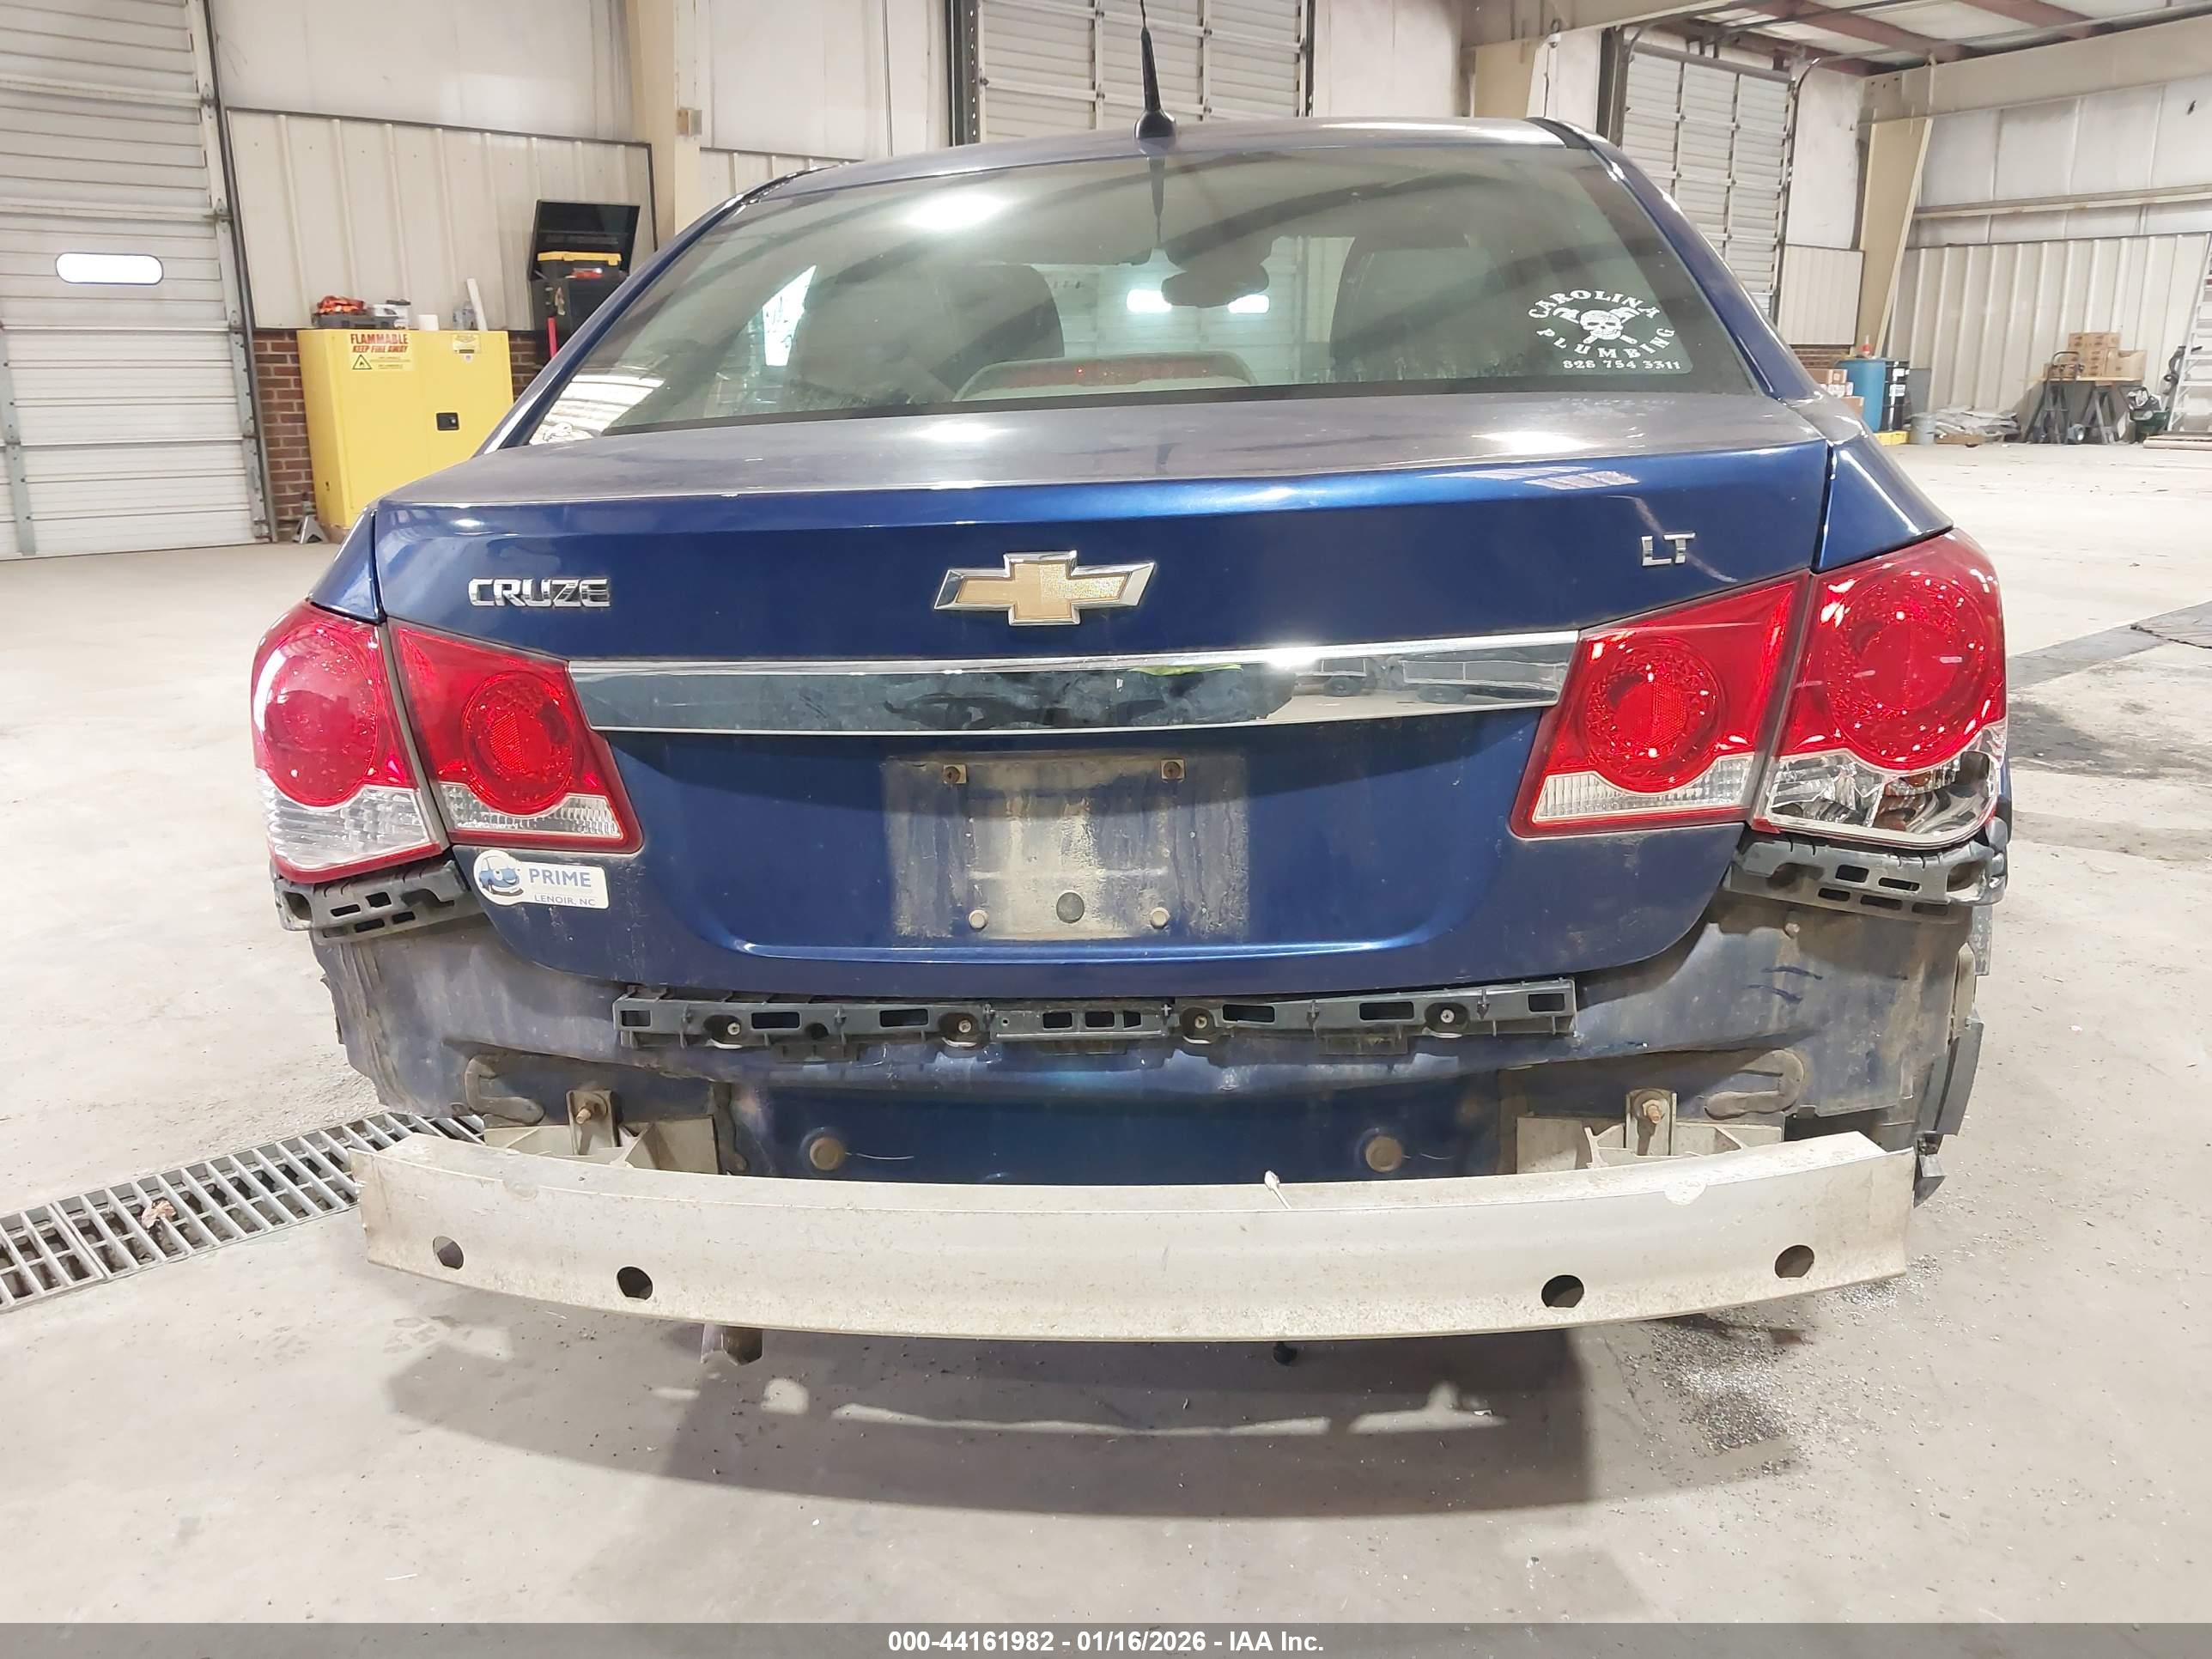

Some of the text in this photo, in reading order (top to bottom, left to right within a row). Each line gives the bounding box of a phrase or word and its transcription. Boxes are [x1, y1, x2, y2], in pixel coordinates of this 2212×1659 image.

[1528, 289, 1661, 319] CAROLINA
[350, 333, 409, 344] FLAMMABLE
[1536, 328, 1676, 359] PLUMBING
[1562, 359, 1681, 370] 828 754 3311
[1641, 532, 1697, 567] LT
[468, 578, 611, 608] CRUZE
[528, 868, 592, 888] PRIME
[534, 895, 577, 905] LENOIR,
